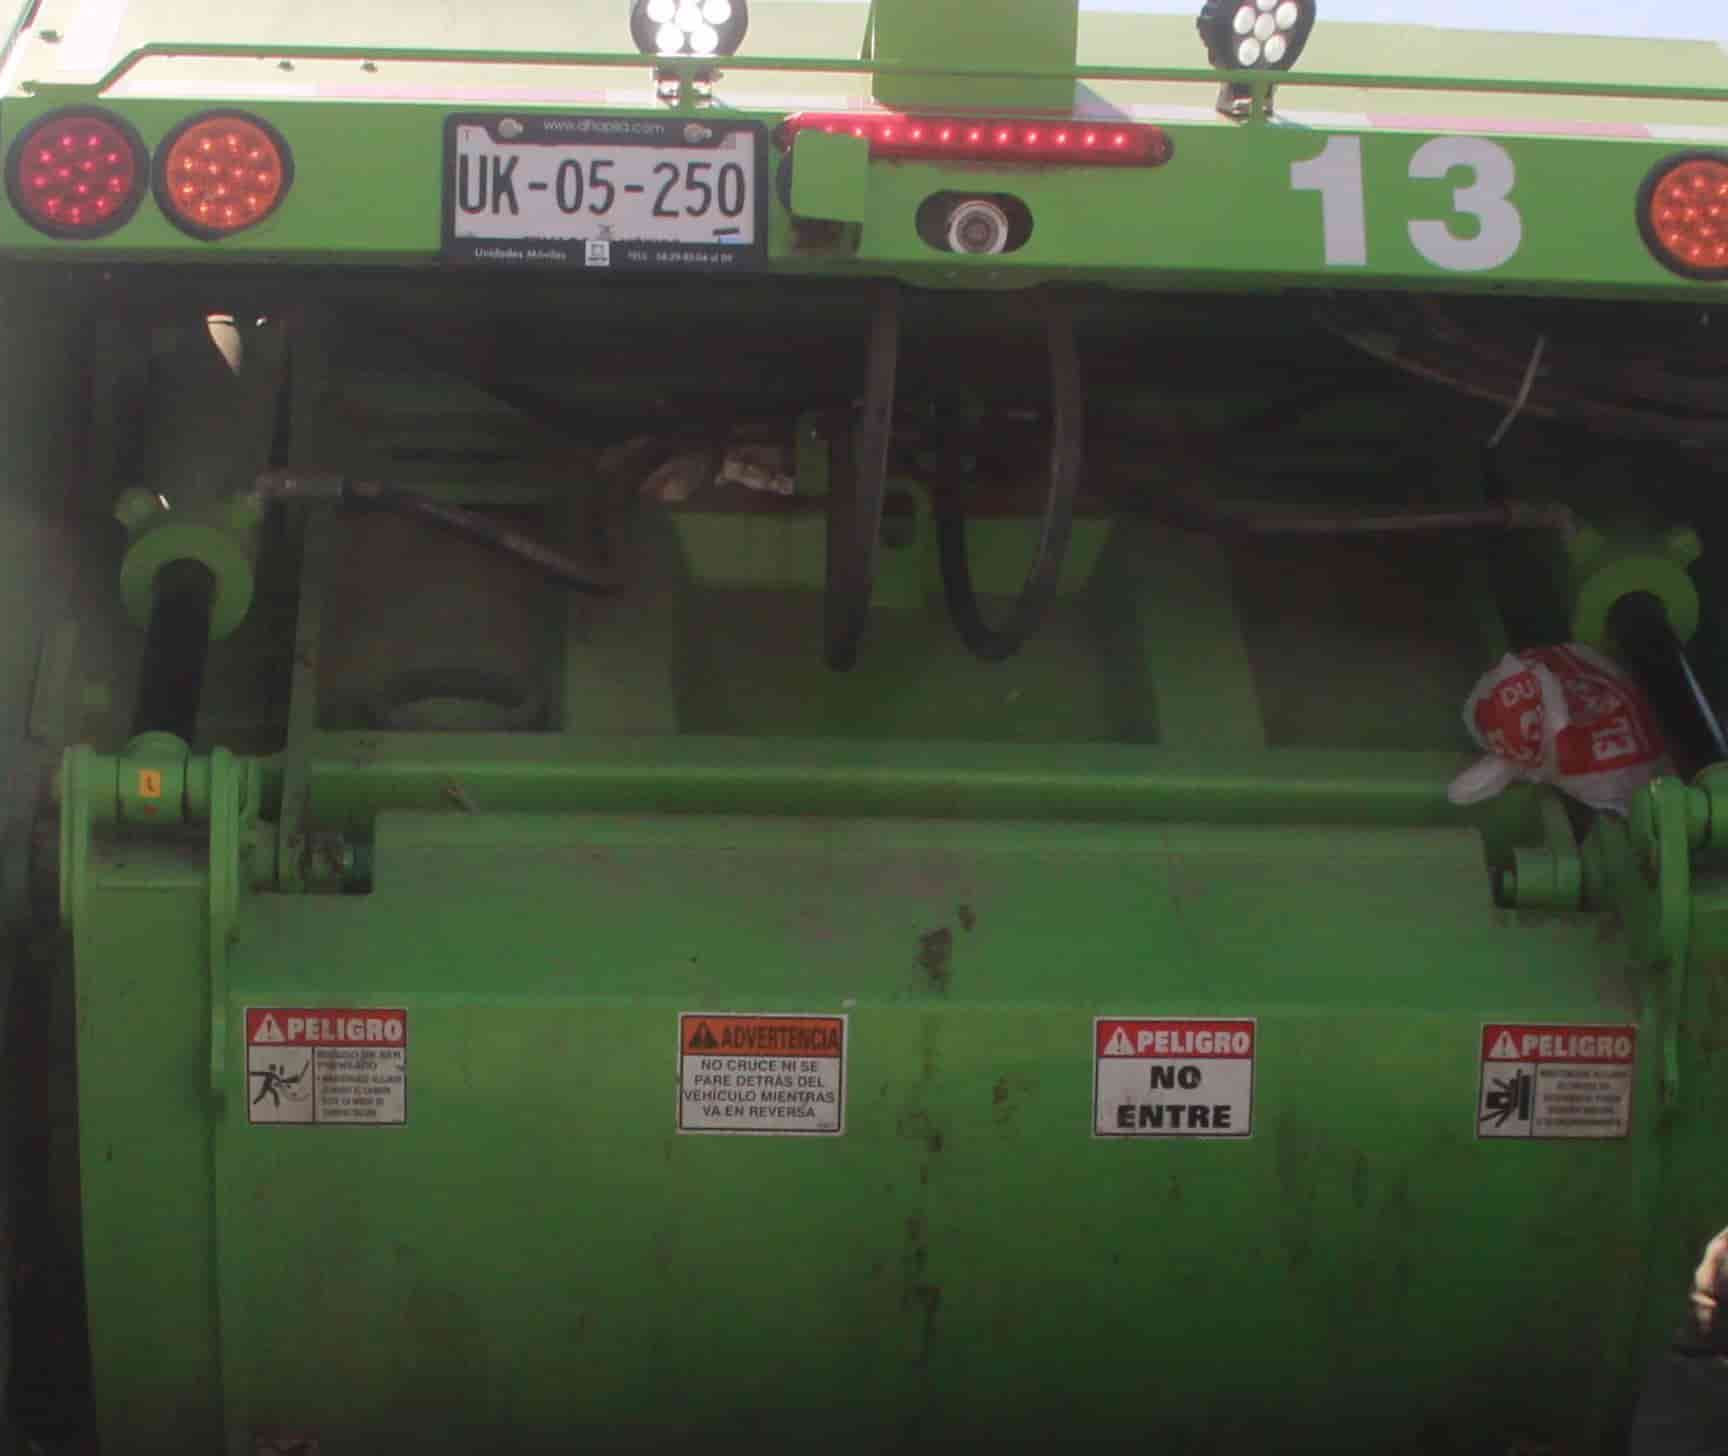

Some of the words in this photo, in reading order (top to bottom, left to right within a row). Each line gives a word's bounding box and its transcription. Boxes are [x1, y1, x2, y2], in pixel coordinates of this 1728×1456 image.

[459, 154, 746, 218] UK-05-250
[1290, 135, 1522, 271] 13
[287, 1017, 403, 1041] PELIGRO
[723, 1027, 839, 1049] ADVERTENCIA
[1136, 1030, 1250, 1054] PELIGRO
[1521, 1034, 1633, 1057] PELIGRO
[701, 1059, 722, 1072] NO
[727, 1059, 777, 1073] CRUCE
[782, 1060, 796, 1072] NI
[800, 1060, 817, 1073] SE
[1150, 1065, 1202, 1090] NO
[694, 1075, 732, 1087] PARE
[797, 1076, 825, 1088] DEL
[761, 1090, 835, 1104] MIENTRAS
[703, 1105, 721, 1117] VA
[725, 1105, 744, 1117] EN
[749, 1106, 816, 1118] REVERSA
[1117, 1104, 1232, 1129] ENTRE
